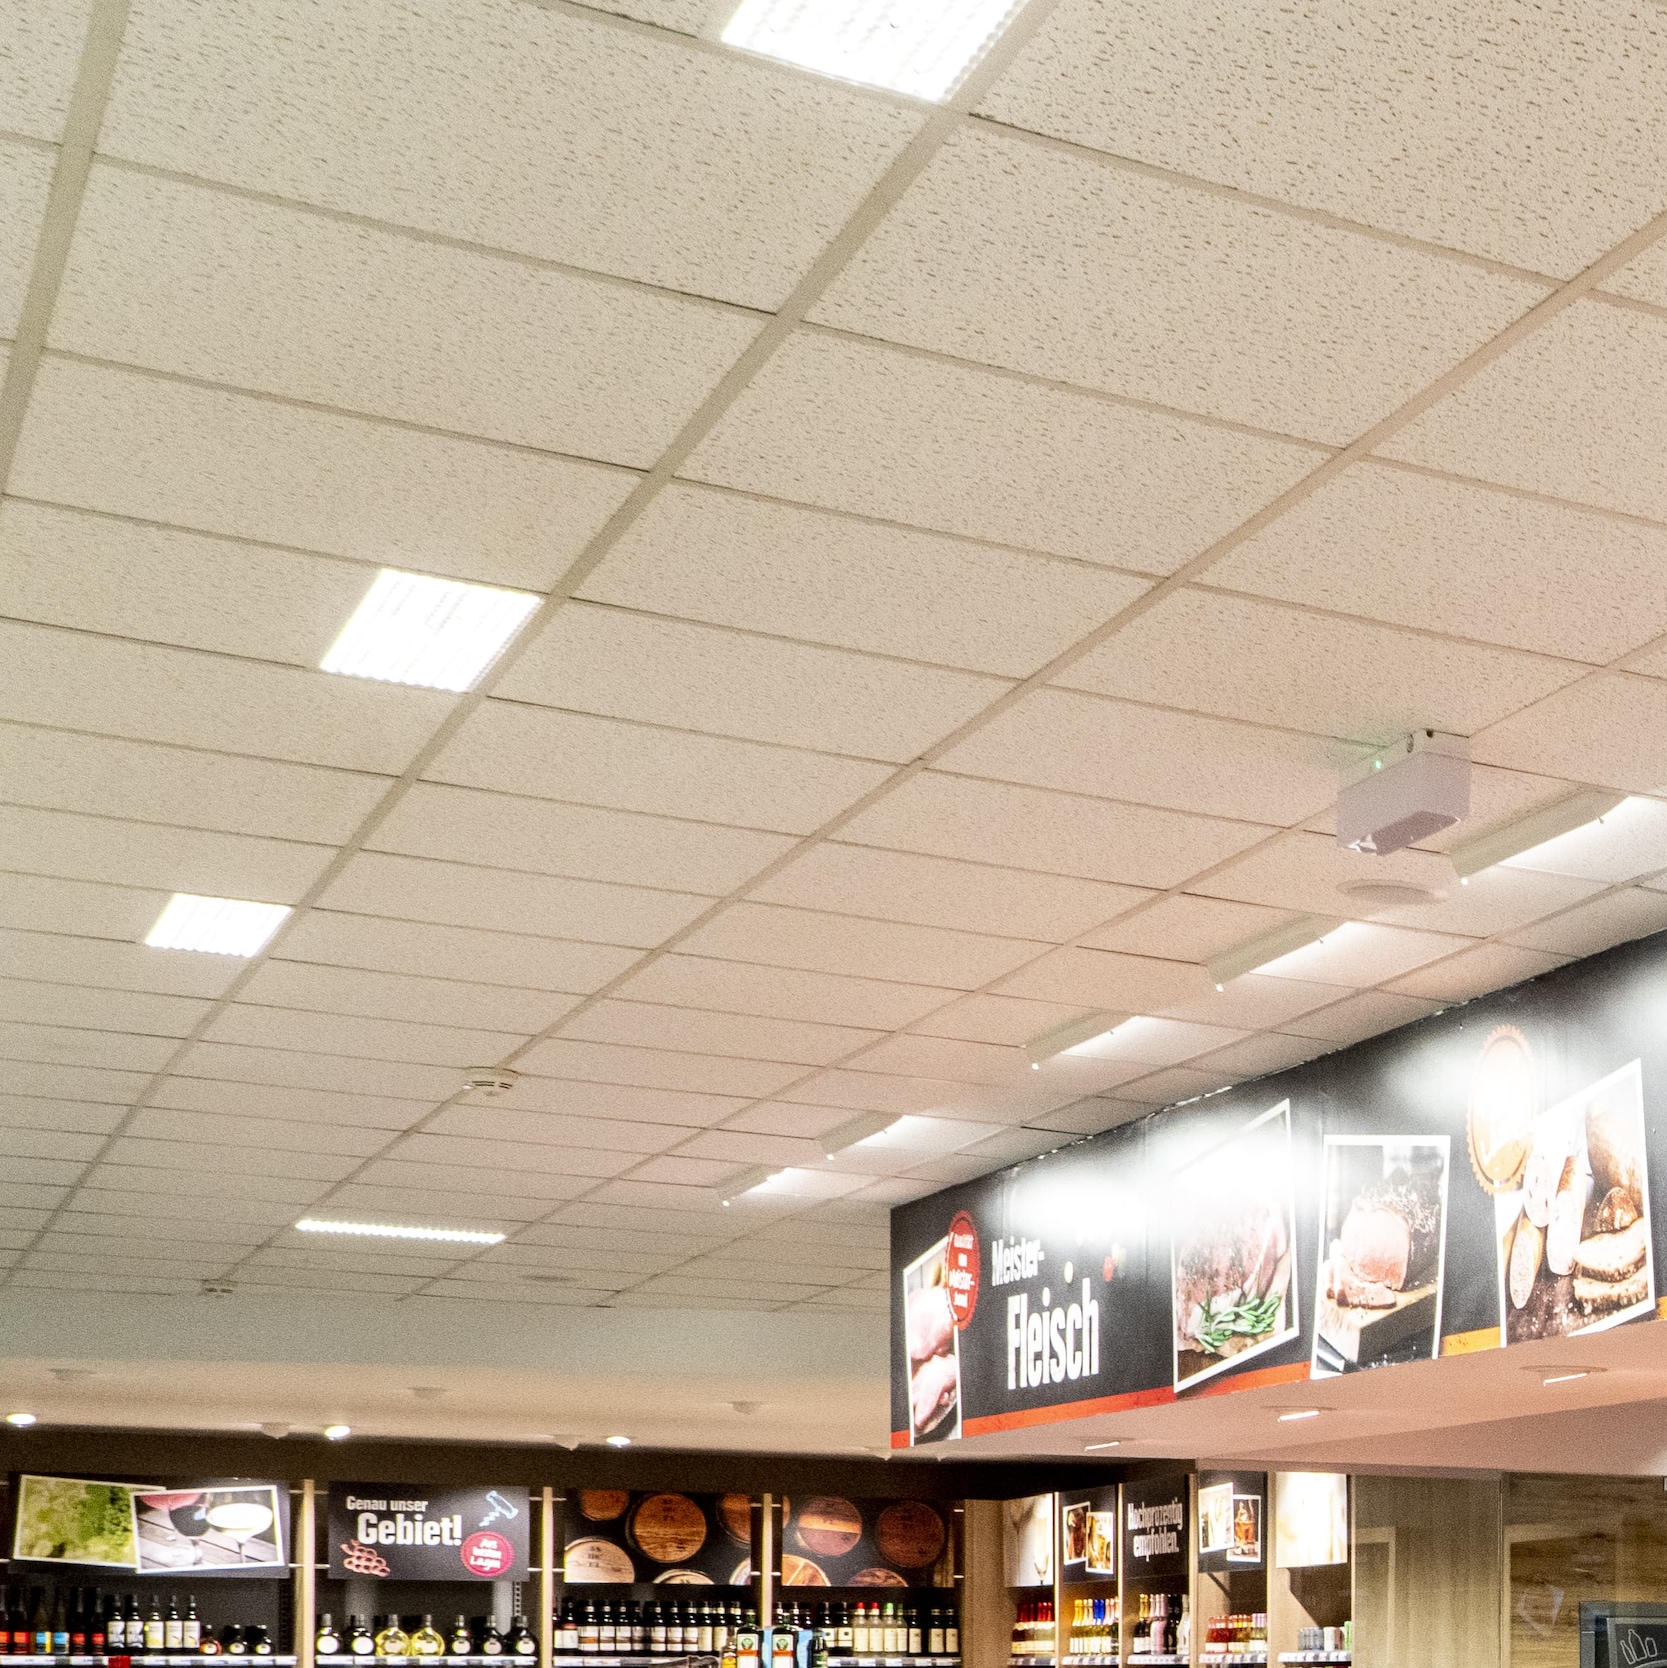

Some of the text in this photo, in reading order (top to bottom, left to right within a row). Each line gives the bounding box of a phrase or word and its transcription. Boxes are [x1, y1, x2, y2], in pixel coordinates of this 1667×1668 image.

[992, 1236, 1045, 1286] Meister-
[1008, 1278, 1099, 1389] Fleisch
[347, 1496, 428, 1513] Genau unser
[1128, 1497, 1182, 1533] Hochprozentig
[358, 1513, 462, 1546] Gebiet!
[1133, 1527, 1179, 1562] empfohlen.
